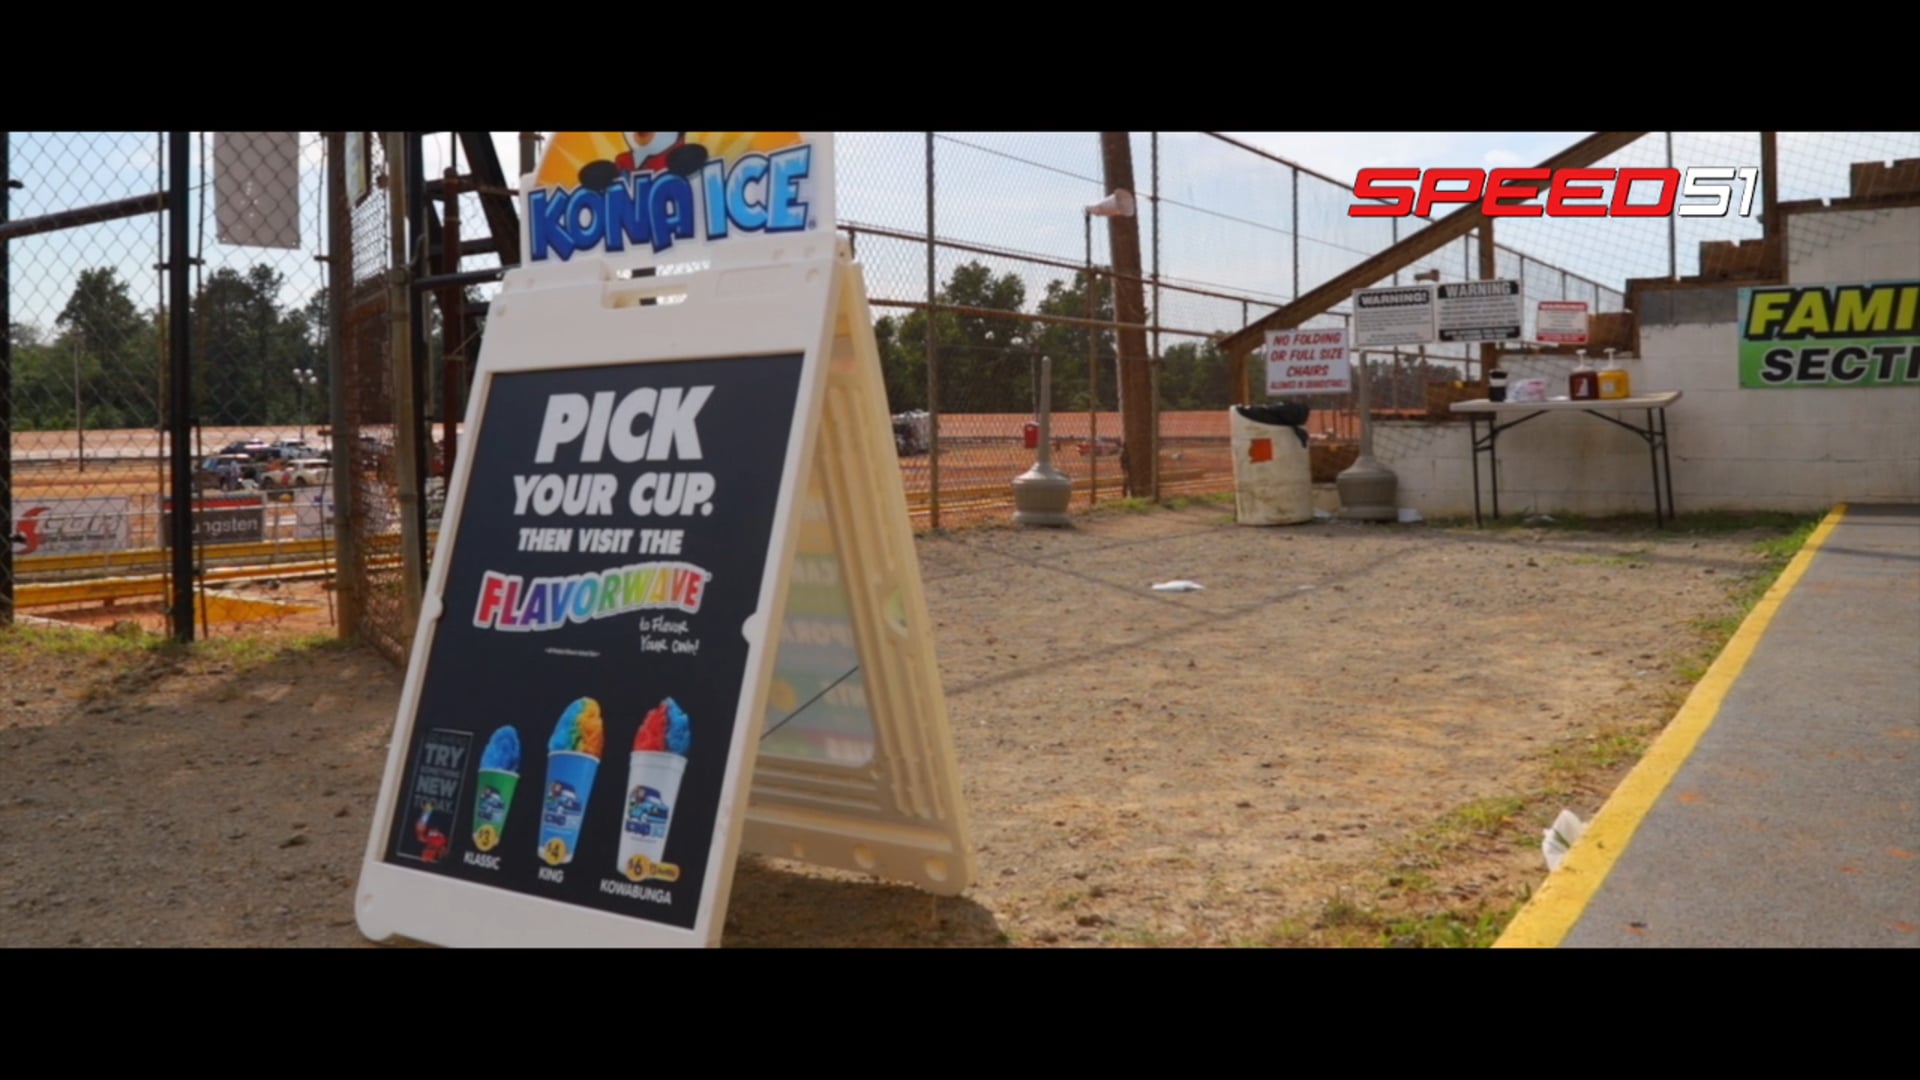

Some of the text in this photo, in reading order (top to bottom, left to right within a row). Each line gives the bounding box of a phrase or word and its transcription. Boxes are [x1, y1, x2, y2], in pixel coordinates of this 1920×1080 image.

[528, 144, 812, 262] KONA ICE
[1446, 282, 1512, 298] WARNING
[1746, 284, 1920, 340] FAMI
[1273, 331, 1341, 346] NO FOLDING
[1271, 347, 1344, 362] OR FULL SIZE
[1286, 364, 1329, 377] CHAIRS
[534, 386, 715, 463] PICK
[513, 472, 716, 516] YOUR CUP.
[518, 528, 684, 554] THEN VISIT THE
[474, 561, 707, 631] FLAVORWAVE
[639, 616, 650, 631] to
[425, 742, 465, 768] TRY
[416, 775, 458, 798] NEW
[464, 851, 501, 870] KLASSIC
[538, 867, 564, 883] KING
[600, 879, 672, 904] KOWABUNGA
